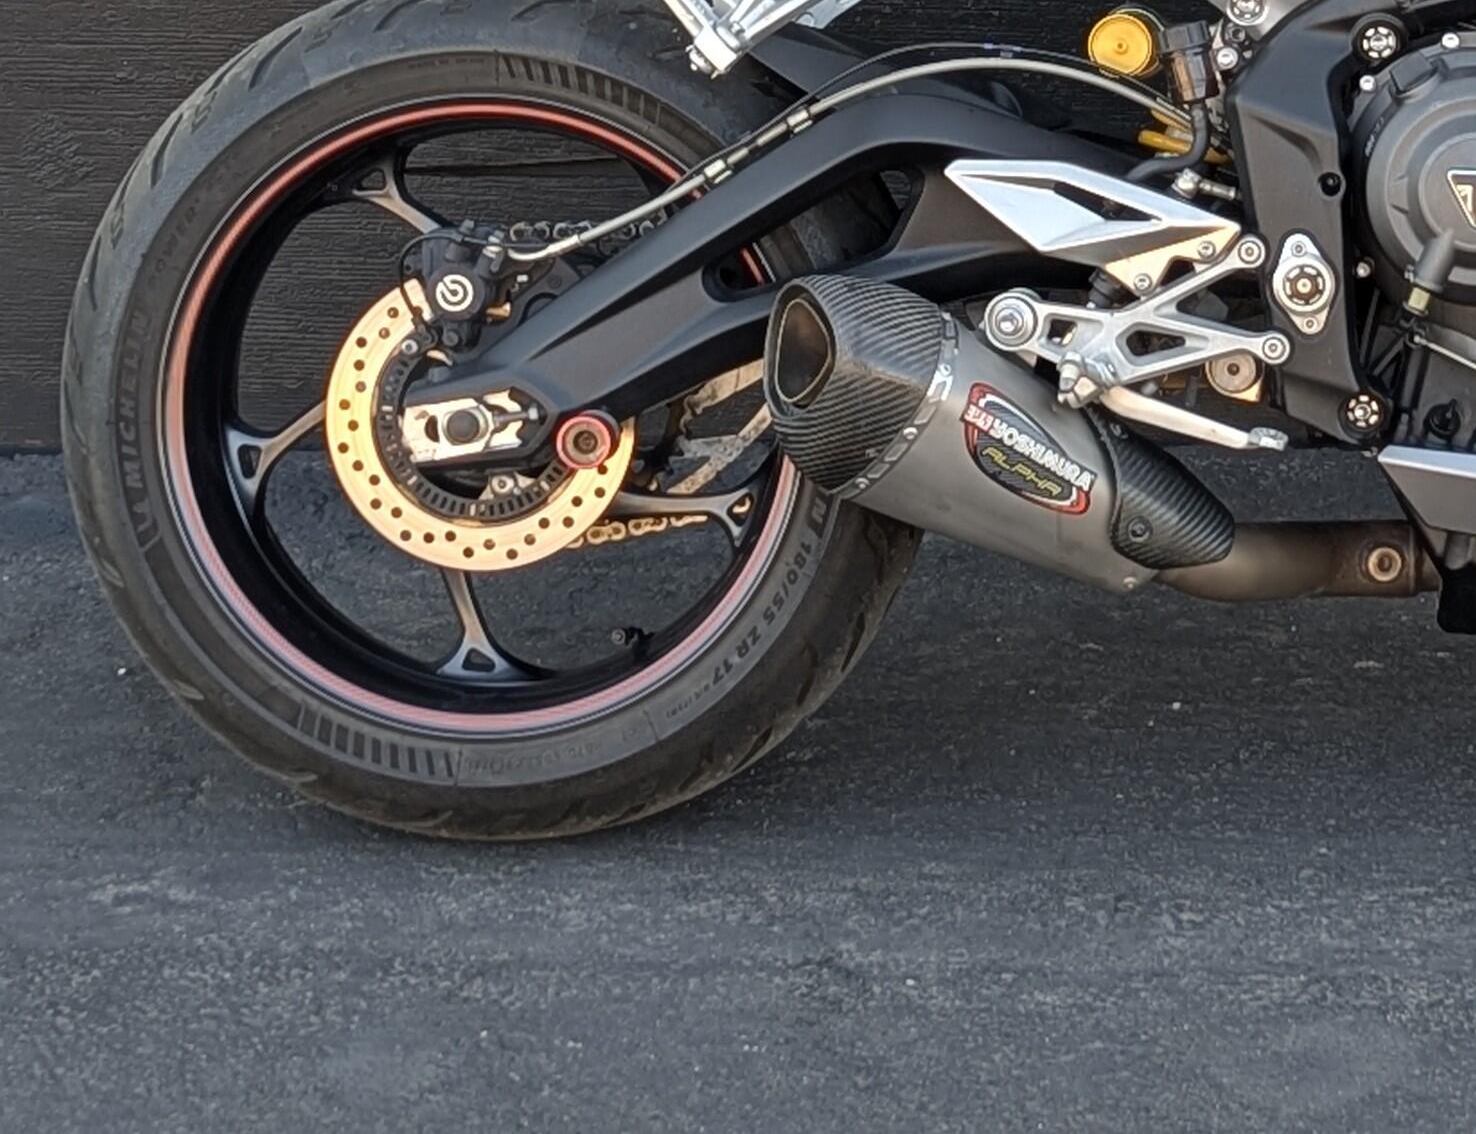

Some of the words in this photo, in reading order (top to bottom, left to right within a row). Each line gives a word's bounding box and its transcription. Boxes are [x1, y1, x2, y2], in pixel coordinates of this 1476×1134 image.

[117, 309, 150, 492] MICHELIN
[982, 446, 1062, 497] ALPHA
[991, 418, 1094, 491] YOSHIMURA
[761, 539, 813, 624] 180/55
[709, 658, 735, 685] 17
[734, 625, 763, 659] ZR
